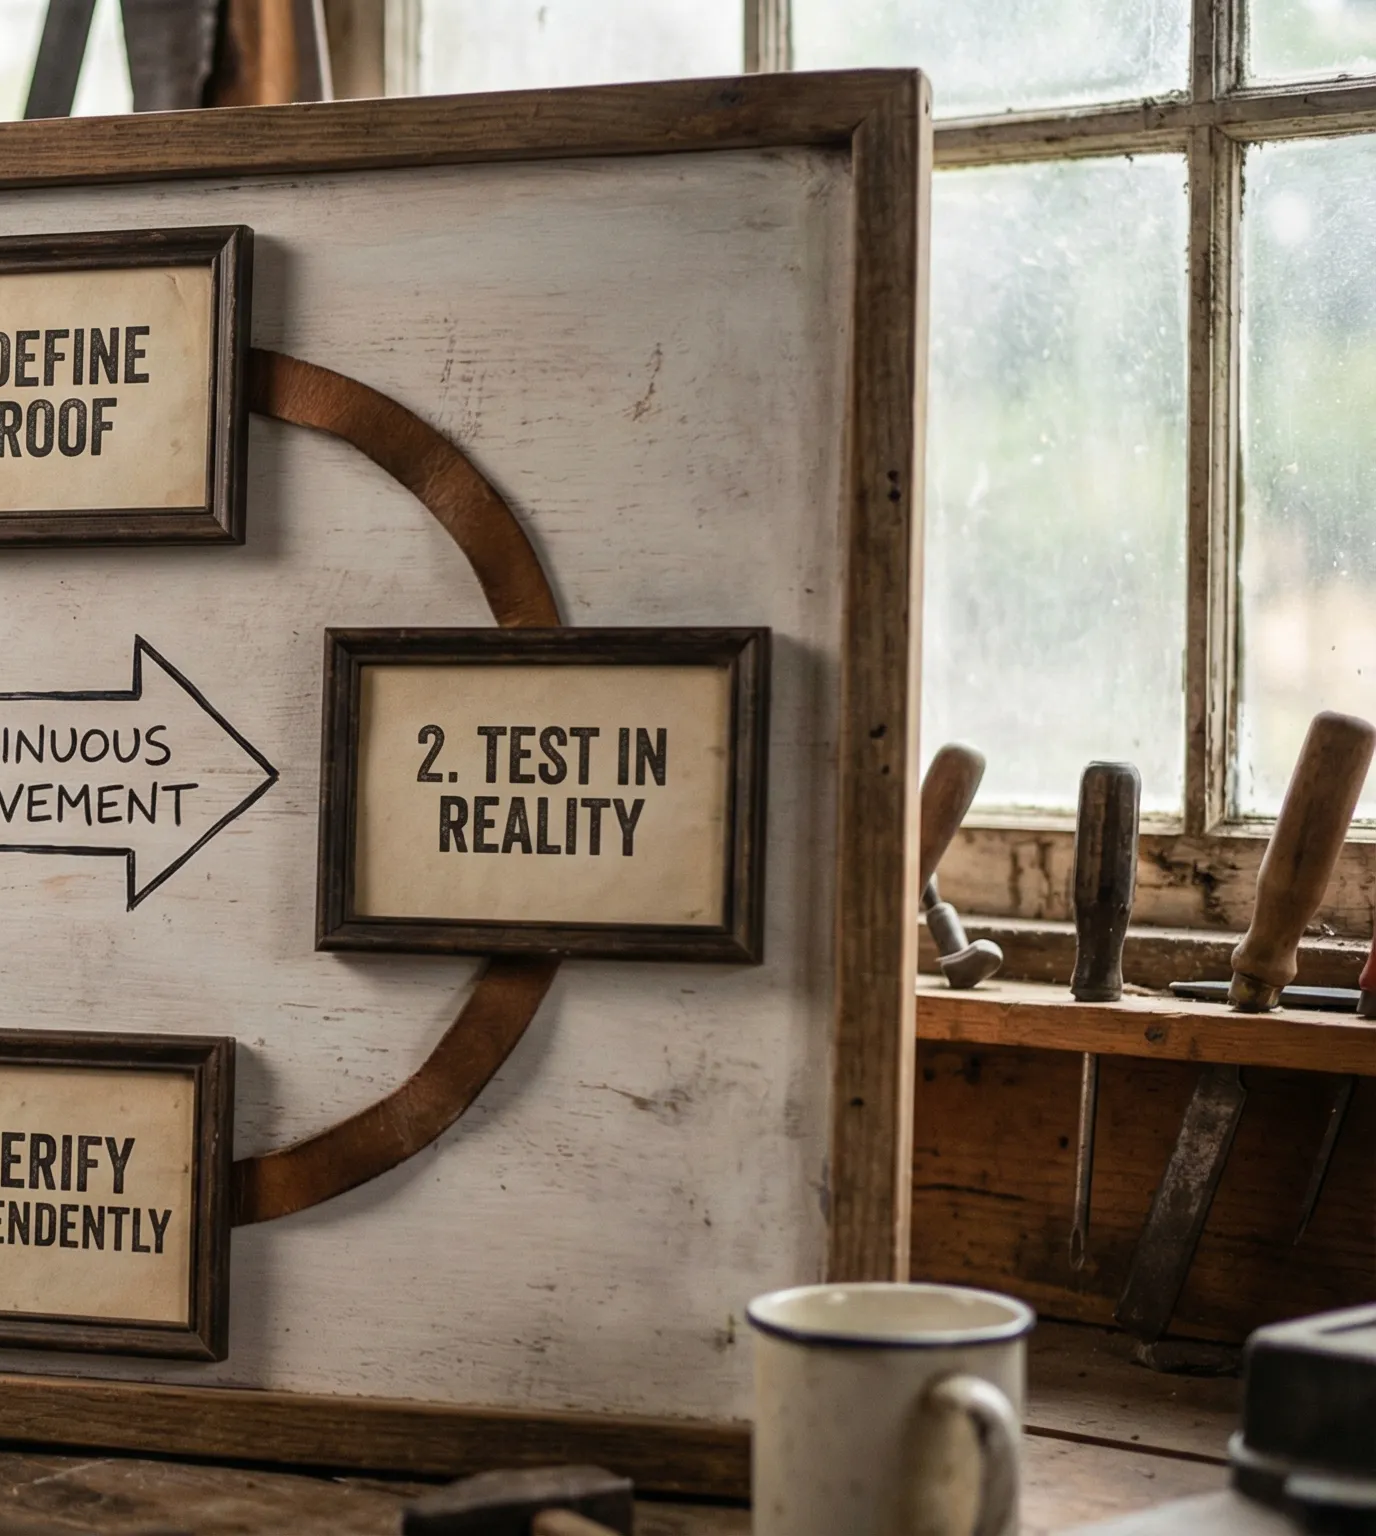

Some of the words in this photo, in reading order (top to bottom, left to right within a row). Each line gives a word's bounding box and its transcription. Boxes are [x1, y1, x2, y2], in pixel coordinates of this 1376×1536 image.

[417, 724, 458, 783] 2.
[477, 725, 600, 786] TEST
[617, 727, 667, 786] IN
[439, 795, 645, 857] REALITY
